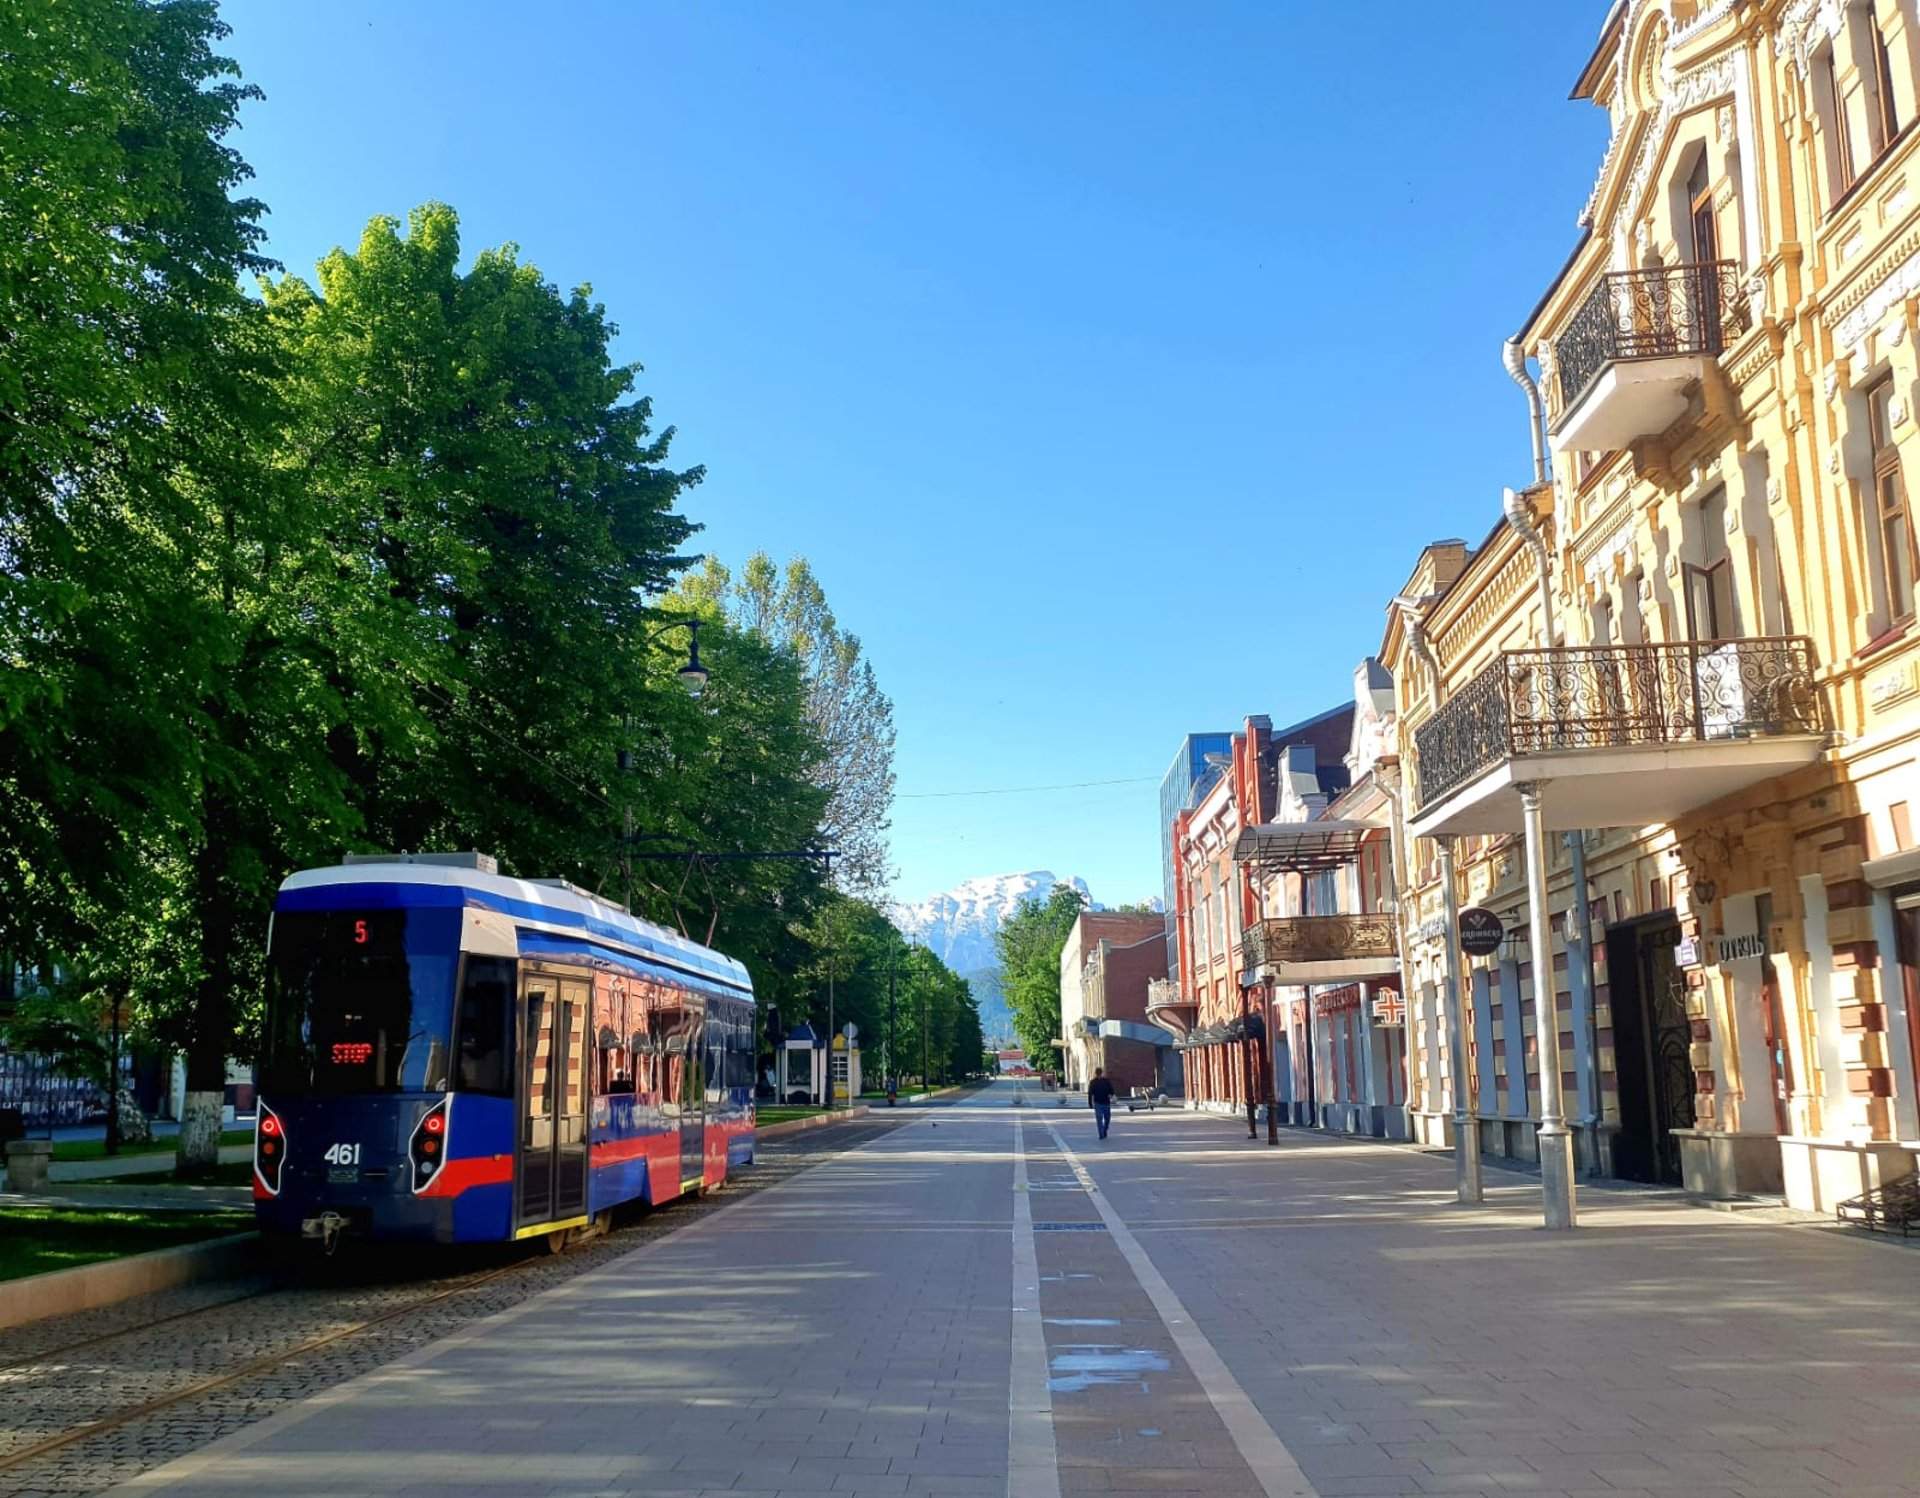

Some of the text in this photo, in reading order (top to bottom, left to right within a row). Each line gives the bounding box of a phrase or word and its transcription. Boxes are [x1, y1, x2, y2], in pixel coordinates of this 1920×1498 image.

[355, 920, 366, 943] 5
[332, 1043, 371, 1063] STOP
[324, 1143, 360, 1165] 461
